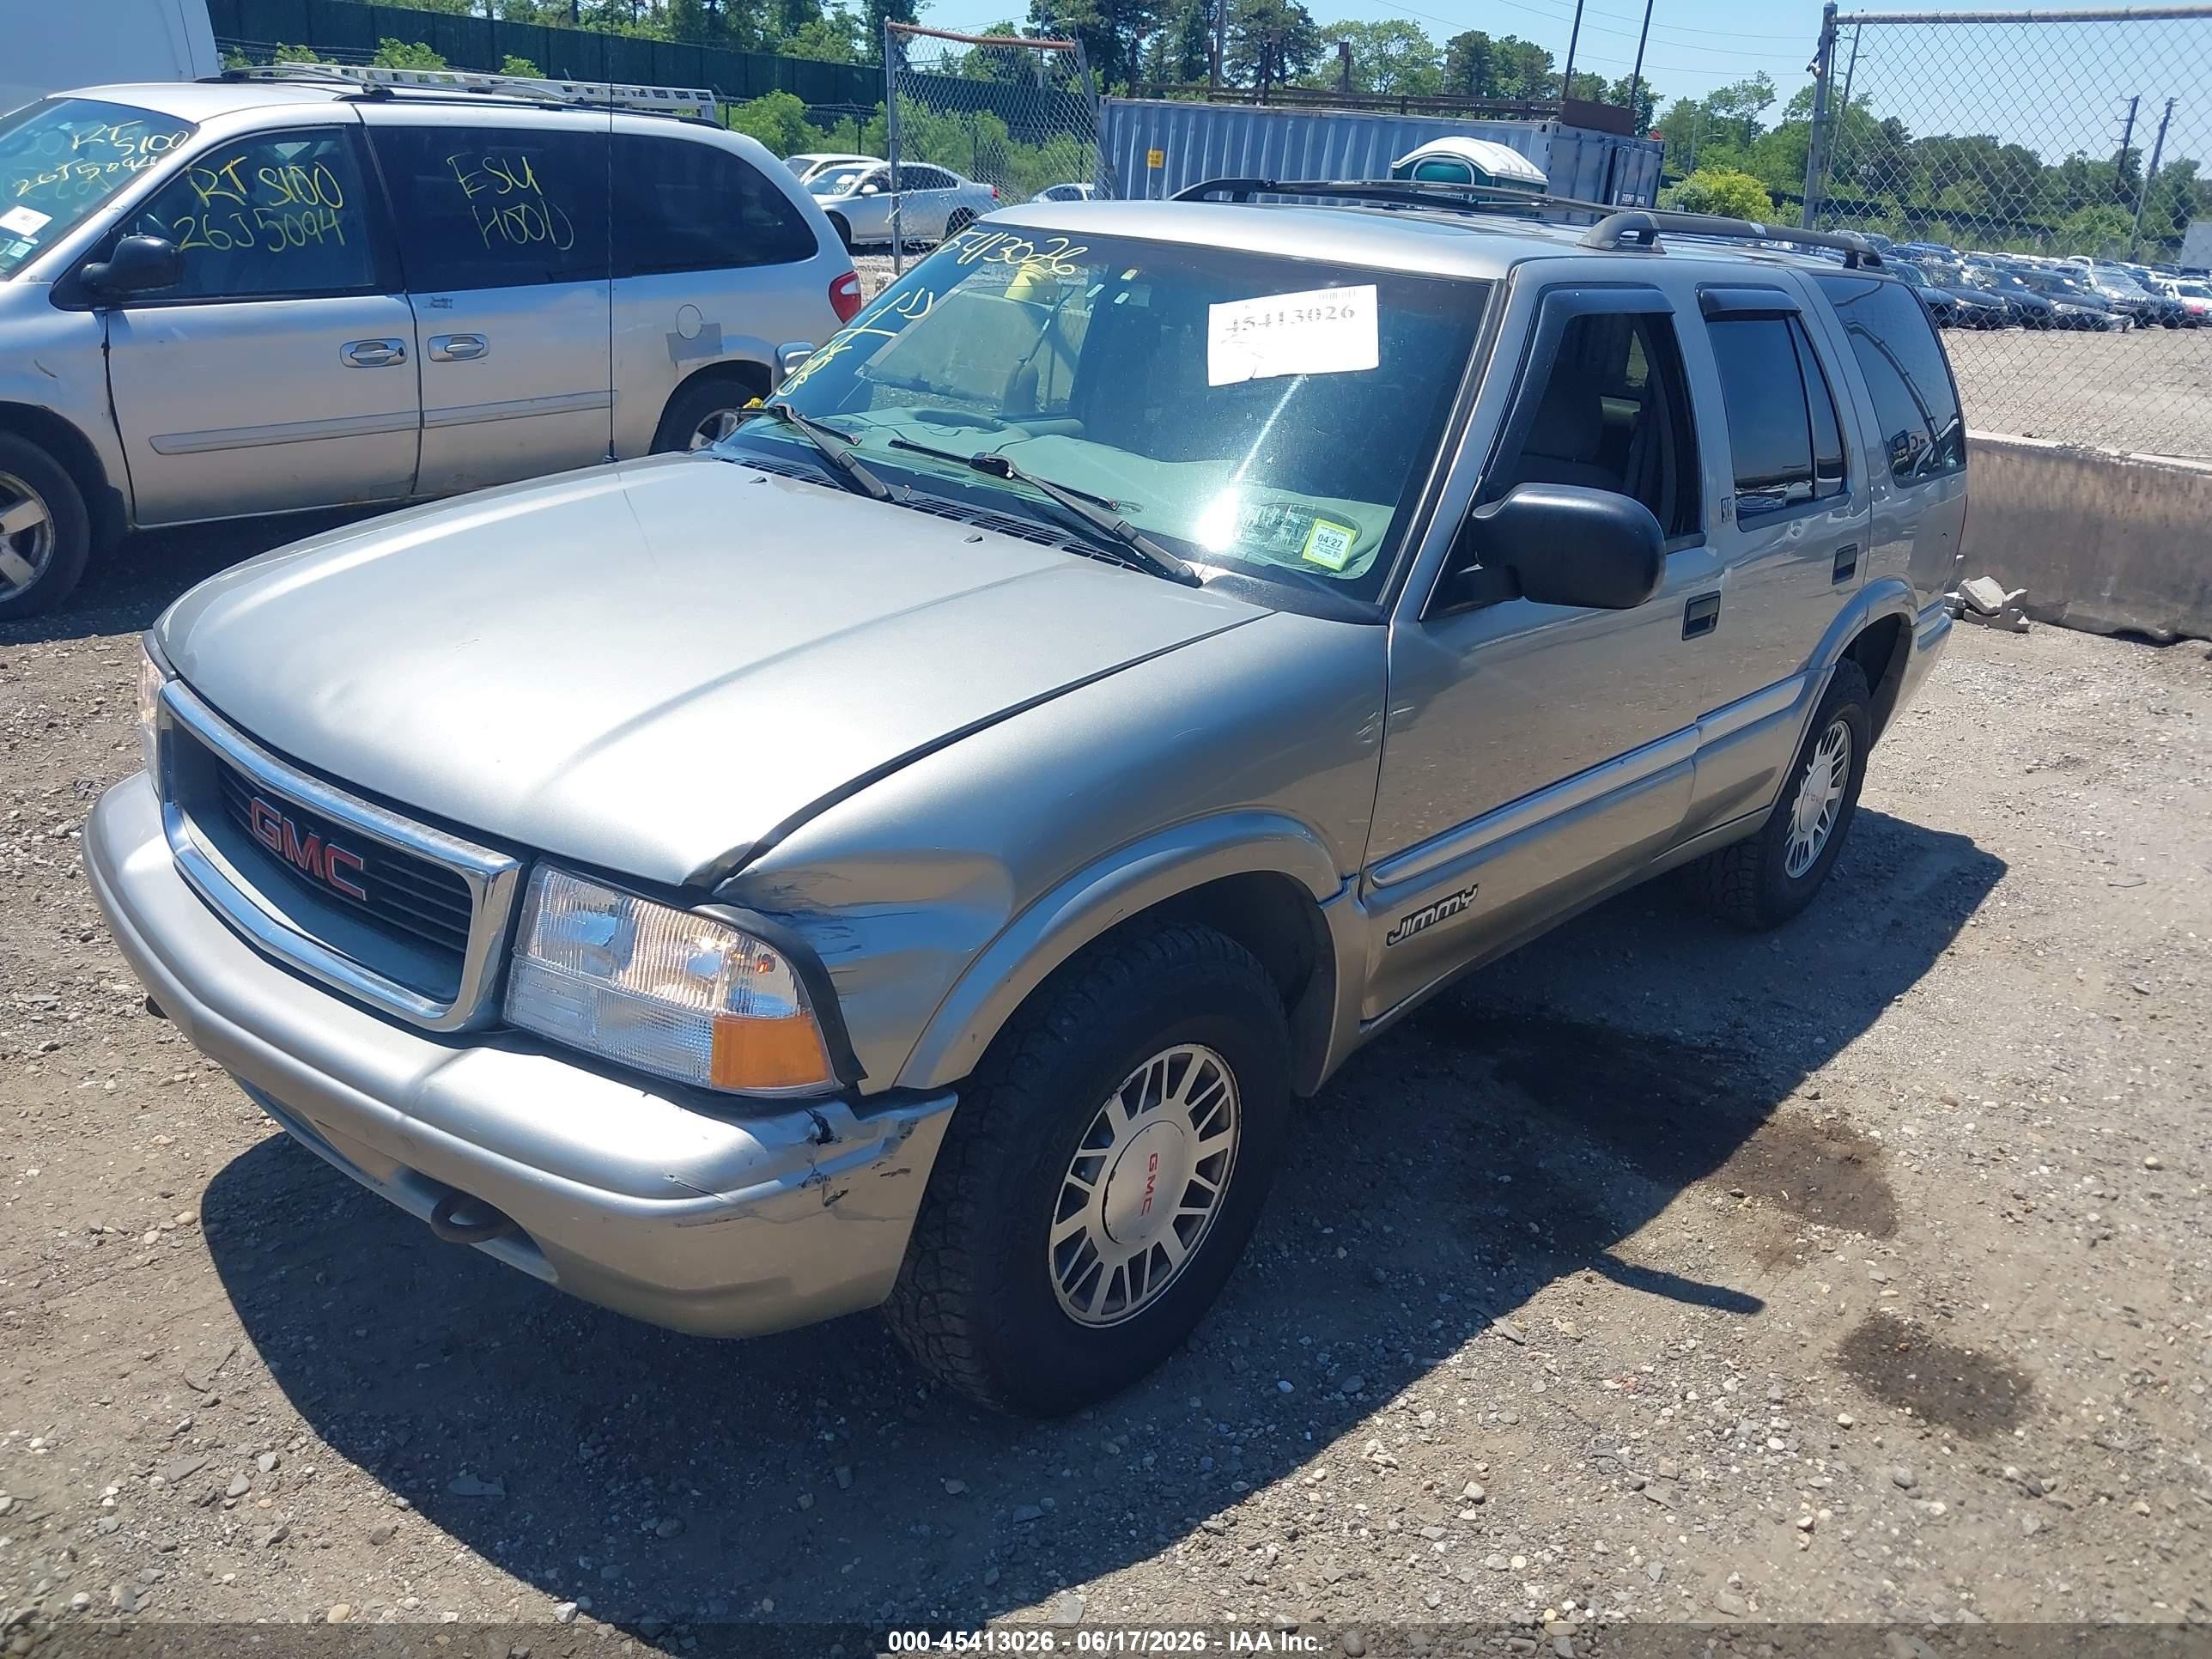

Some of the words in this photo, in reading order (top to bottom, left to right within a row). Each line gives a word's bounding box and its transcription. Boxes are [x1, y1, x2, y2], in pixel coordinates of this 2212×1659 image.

[72, 119, 144, 151] RT
[186, 155, 248, 208] RT
[471, 196, 575, 251] HOOD
[251, 797, 368, 902] GMC
[1141, 1152, 1158, 1217] GMC
